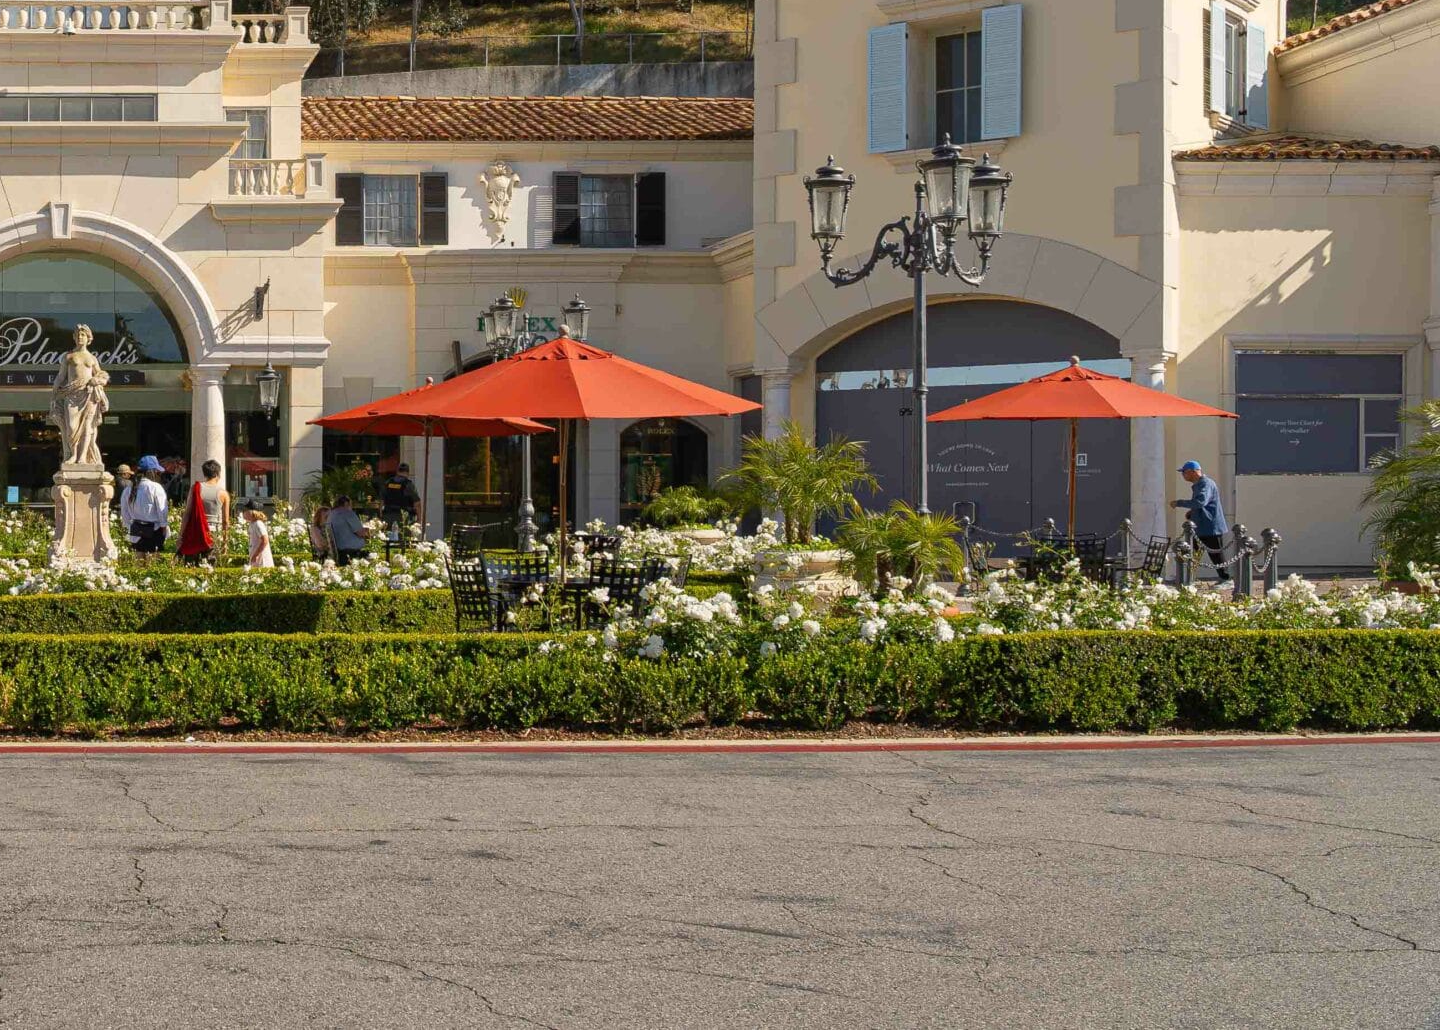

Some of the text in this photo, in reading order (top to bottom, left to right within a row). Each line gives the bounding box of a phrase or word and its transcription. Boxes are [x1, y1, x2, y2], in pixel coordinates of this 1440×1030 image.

[927, 462, 1010, 473] What Comes Next
